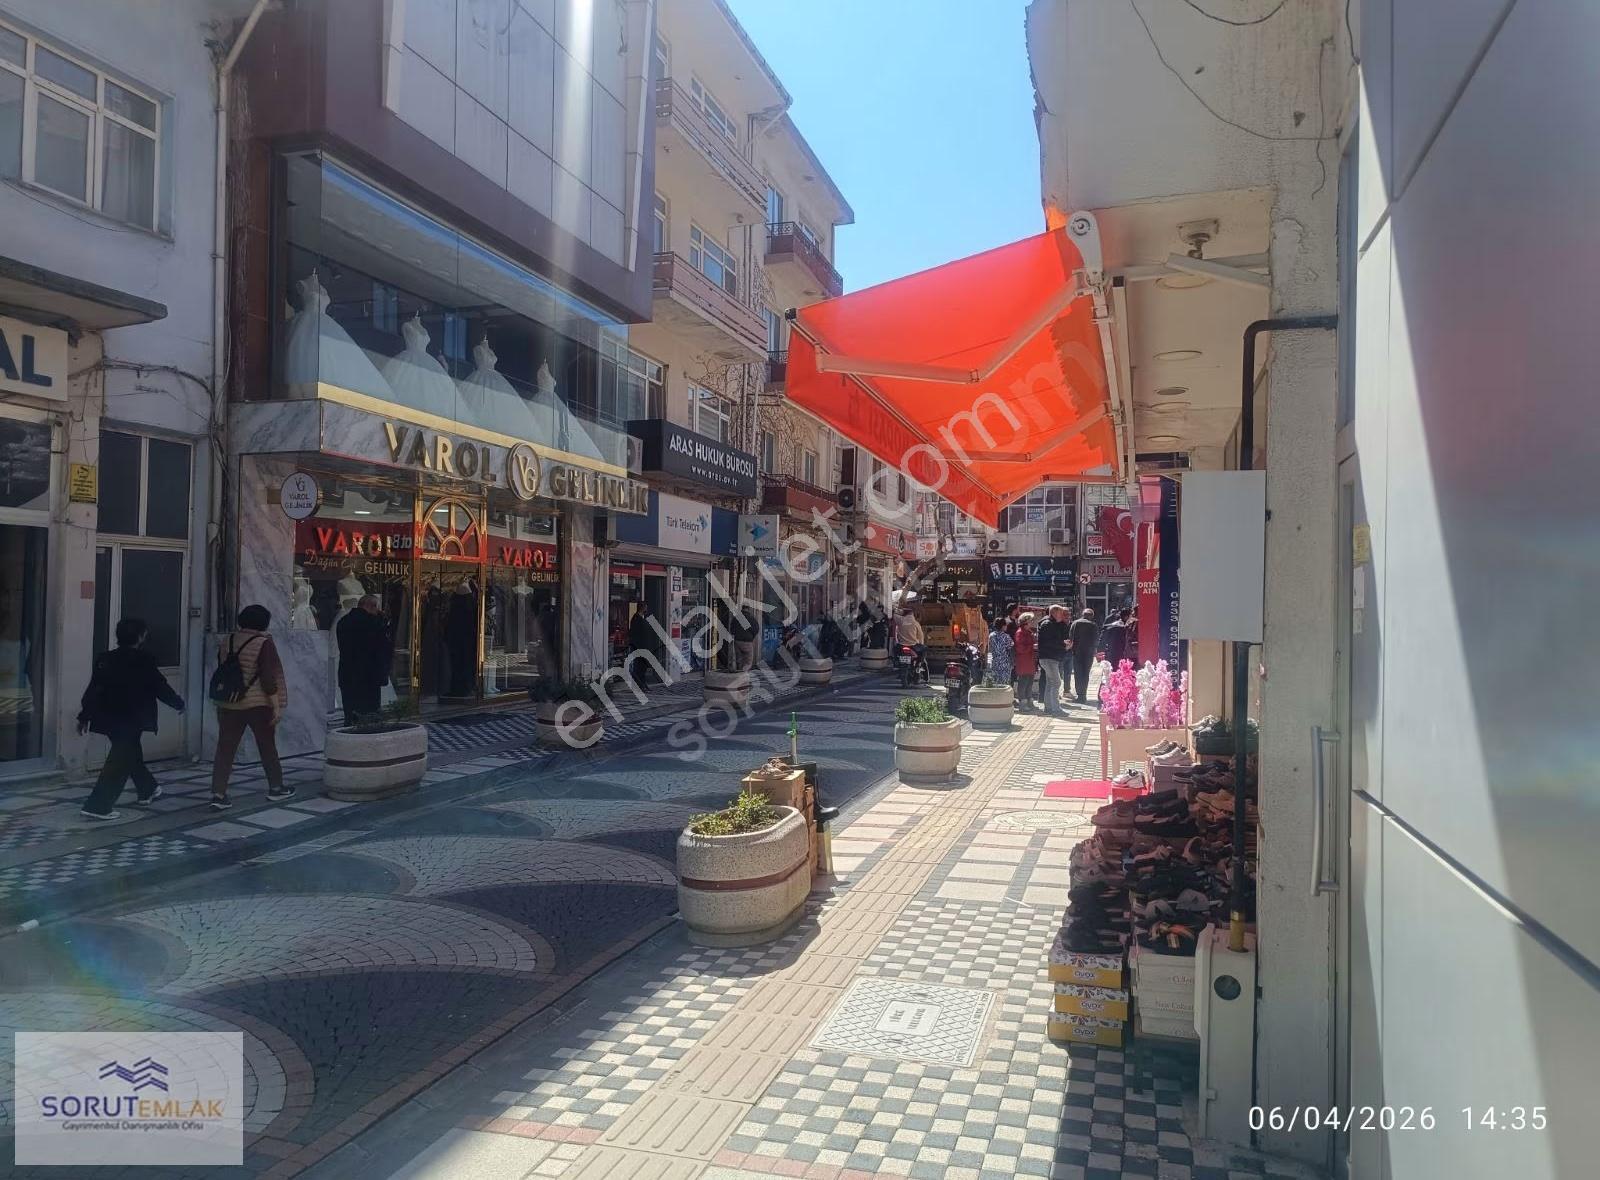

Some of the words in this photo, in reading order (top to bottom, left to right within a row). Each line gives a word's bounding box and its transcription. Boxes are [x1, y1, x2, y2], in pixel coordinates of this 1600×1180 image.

[383, 422, 497, 482] VAROL
[550, 465, 648, 513] GELİNLİK
[670, 434, 693, 456] ARAS
[696, 442, 724, 467] HUKUK
[726, 452, 754, 478] BÜROSU
[666, 516, 678, 529] Türk
[679, 518, 700, 532] Telekom
[316, 527, 396, 557] VAROL
[364, 560, 409, 575] GELİNLİK
[503, 546, 552, 569] VAROL
[1004, 562, 1044, 576] BETA
